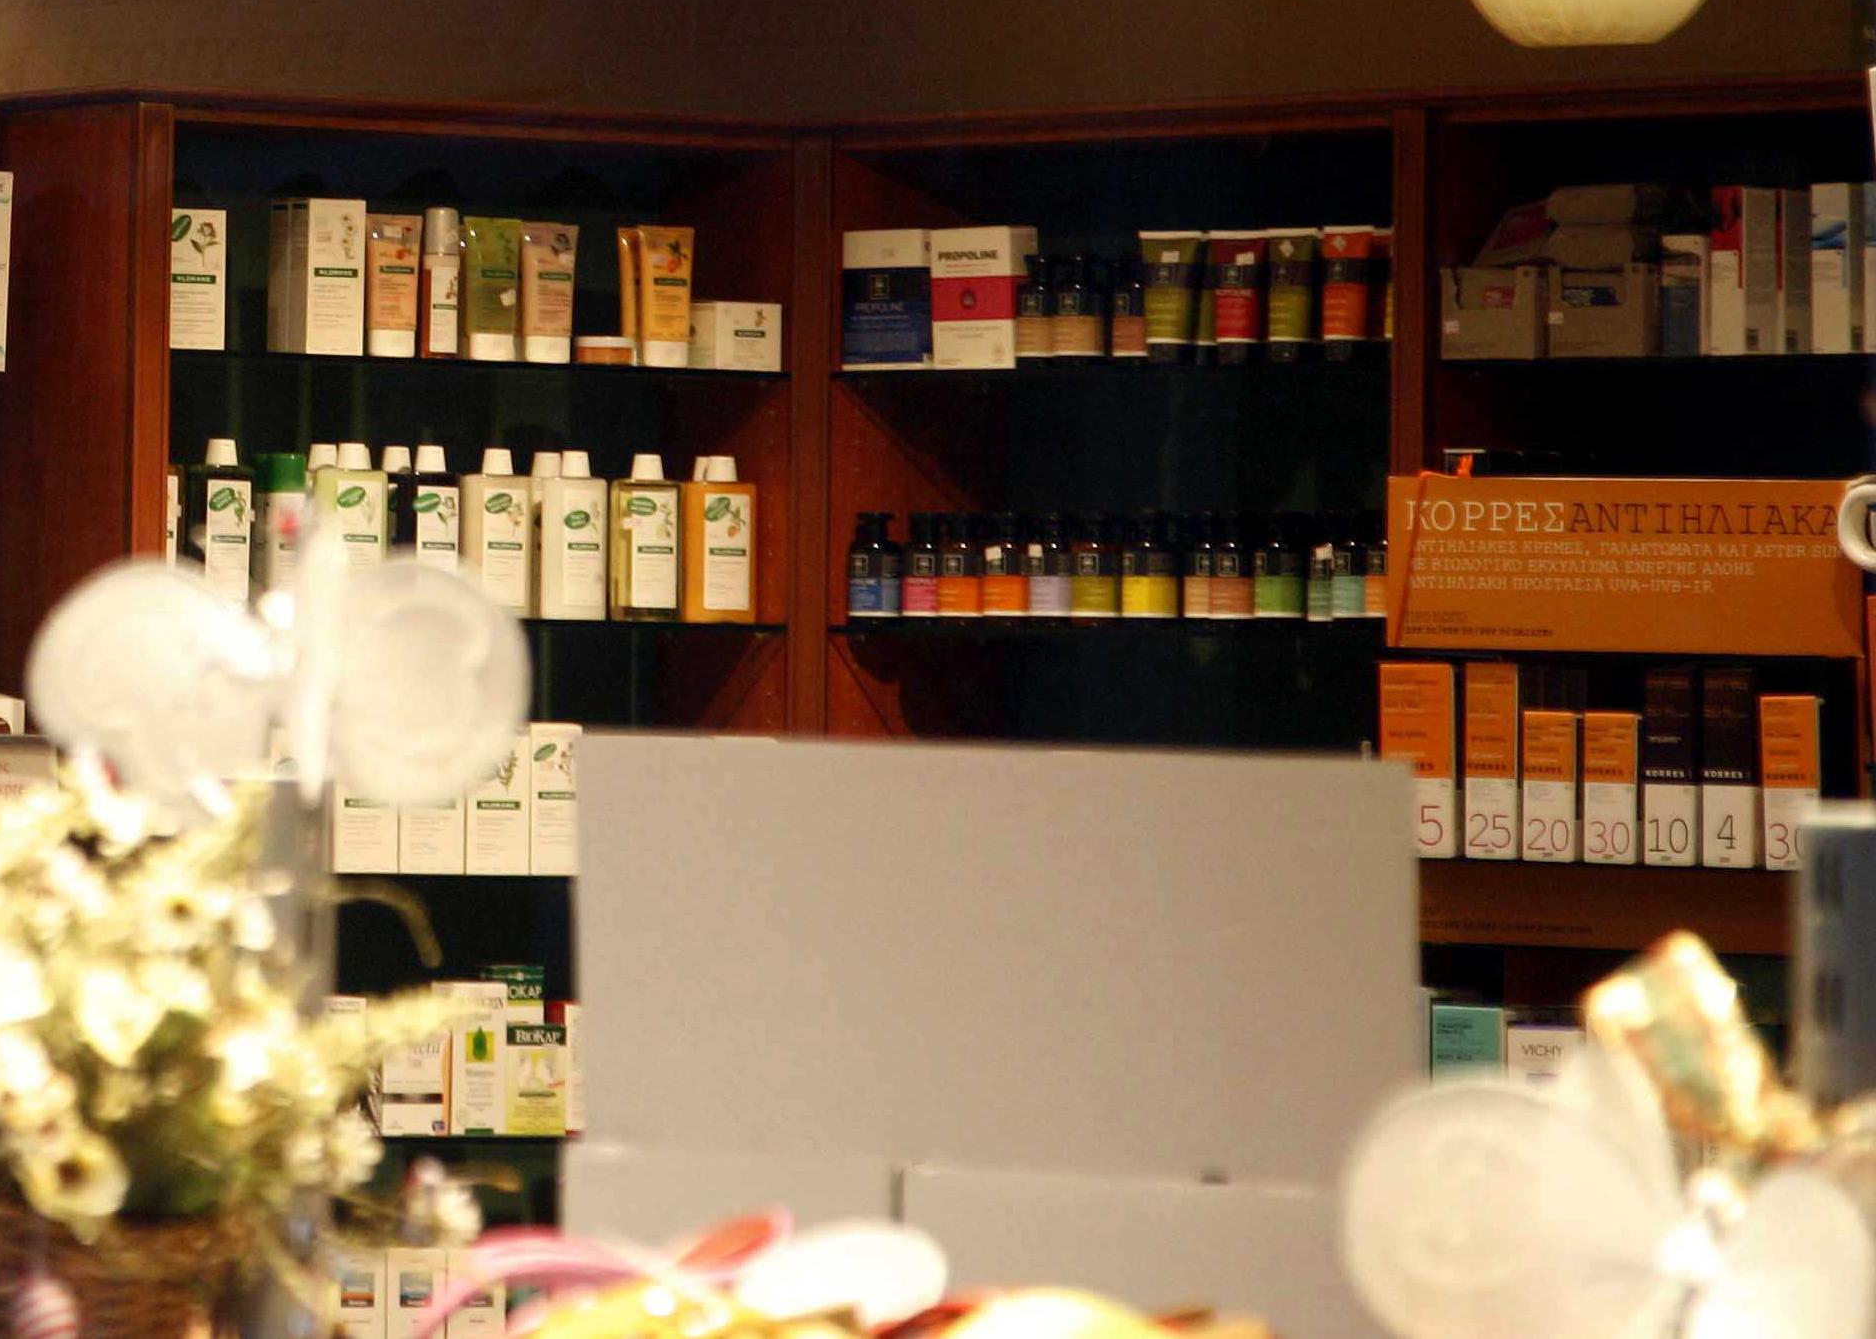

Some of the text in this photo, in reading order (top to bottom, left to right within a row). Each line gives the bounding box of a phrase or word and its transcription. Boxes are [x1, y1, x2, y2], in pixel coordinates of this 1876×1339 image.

[936, 249, 999, 263] PROPOLINE
[1405, 500, 1838, 536] ΚΟΡΡΕΣ ΑΝΤΙΗΛΙΑΚΑ
[1415, 539, 1517, 555] ΝΤΙΗΛΙΑΚΕΣ
[1418, 804, 1444, 846] 5
[1468, 813, 1512, 849] 25
[1527, 818, 1570, 852] 20
[1589, 821, 1631, 855] 30
[1648, 818, 1689, 854] 10
[1716, 815, 1737, 850] 4
[1521, 1044, 1564, 1058] VICHY
